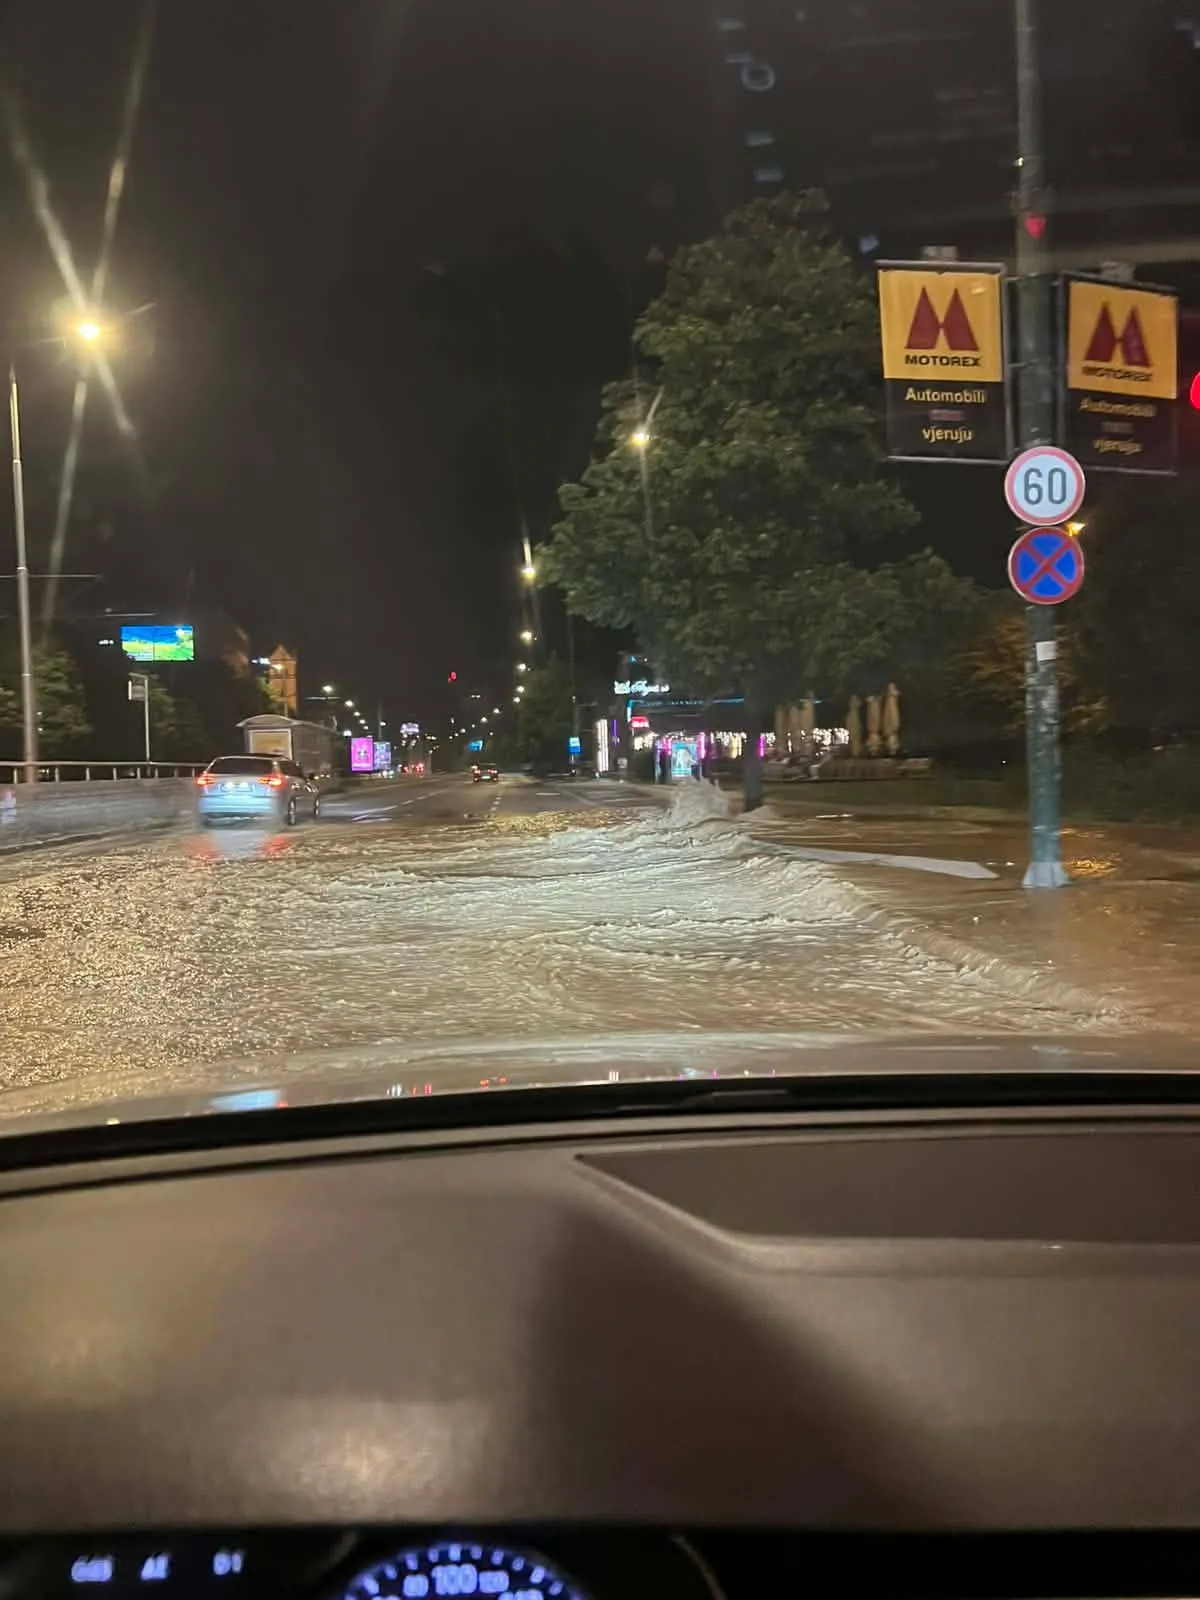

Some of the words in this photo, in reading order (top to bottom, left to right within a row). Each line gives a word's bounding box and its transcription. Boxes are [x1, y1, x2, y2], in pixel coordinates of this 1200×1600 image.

[904, 354, 982, 368] MOTOREX
[904, 387, 985, 403] Automobili
[922, 425, 974, 444] vjeruju
[1023, 467, 1067, 505] 60
[431, 1564, 477, 1595] 100
